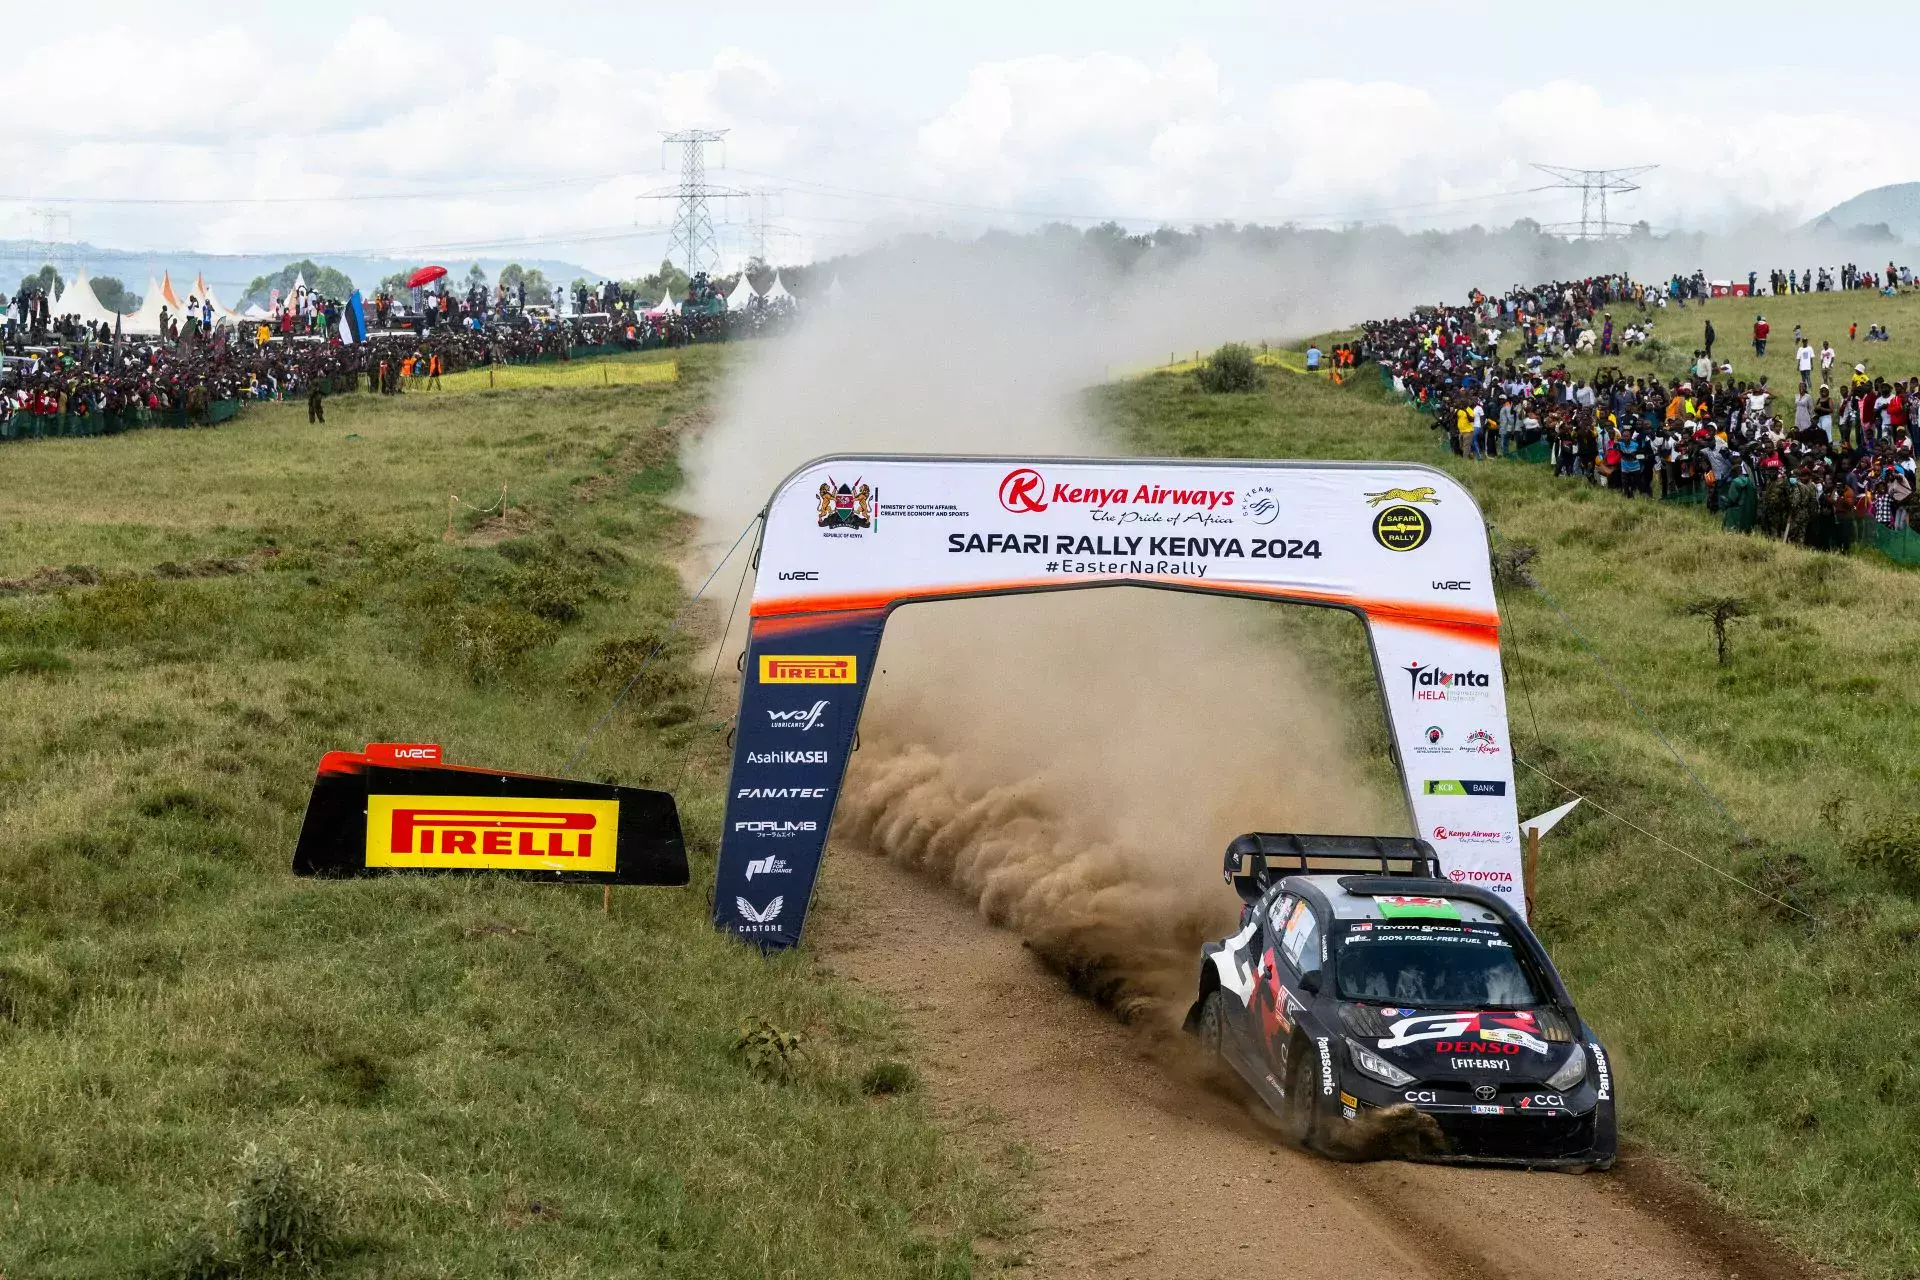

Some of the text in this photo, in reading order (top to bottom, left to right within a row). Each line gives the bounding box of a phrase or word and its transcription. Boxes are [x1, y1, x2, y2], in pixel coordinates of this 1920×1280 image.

[1052, 484, 1128, 508] Kenya
[1132, 485, 1235, 509] Airways
[1090, 509, 1235, 526] The Pride of Africa
[1386, 515, 1417, 523] SAFARI
[948, 533, 1322, 559] SAFARI RALLY KENYA 2024
[1045, 559, 1208, 577] #EasterNaRally
[778, 571, 819, 581] WRC
[1432, 580, 1471, 590] WRC
[769, 661, 848, 678] PIRELLI
[1418, 691, 1446, 700] HELA
[394, 748, 436, 759] WRC
[746, 751, 828, 763] AsahiKASEI
[737, 788, 825, 798] FANATEC
[1473, 784, 1495, 792] BANK
[735, 821, 817, 831] FORUM8
[391, 809, 597, 857] PIRELLI
[1448, 830, 1471, 839] Kenya
[1471, 831, 1500, 839] Airways
[1467, 871, 1513, 881] TOYOTA
[1492, 884, 1512, 893] cfao
[739, 924, 783, 932] CASTORE
[1463, 927, 1500, 936] Racing
[1435, 1041, 1520, 1055] DENSO
[1316, 1036, 1336, 1096] Panasonic
